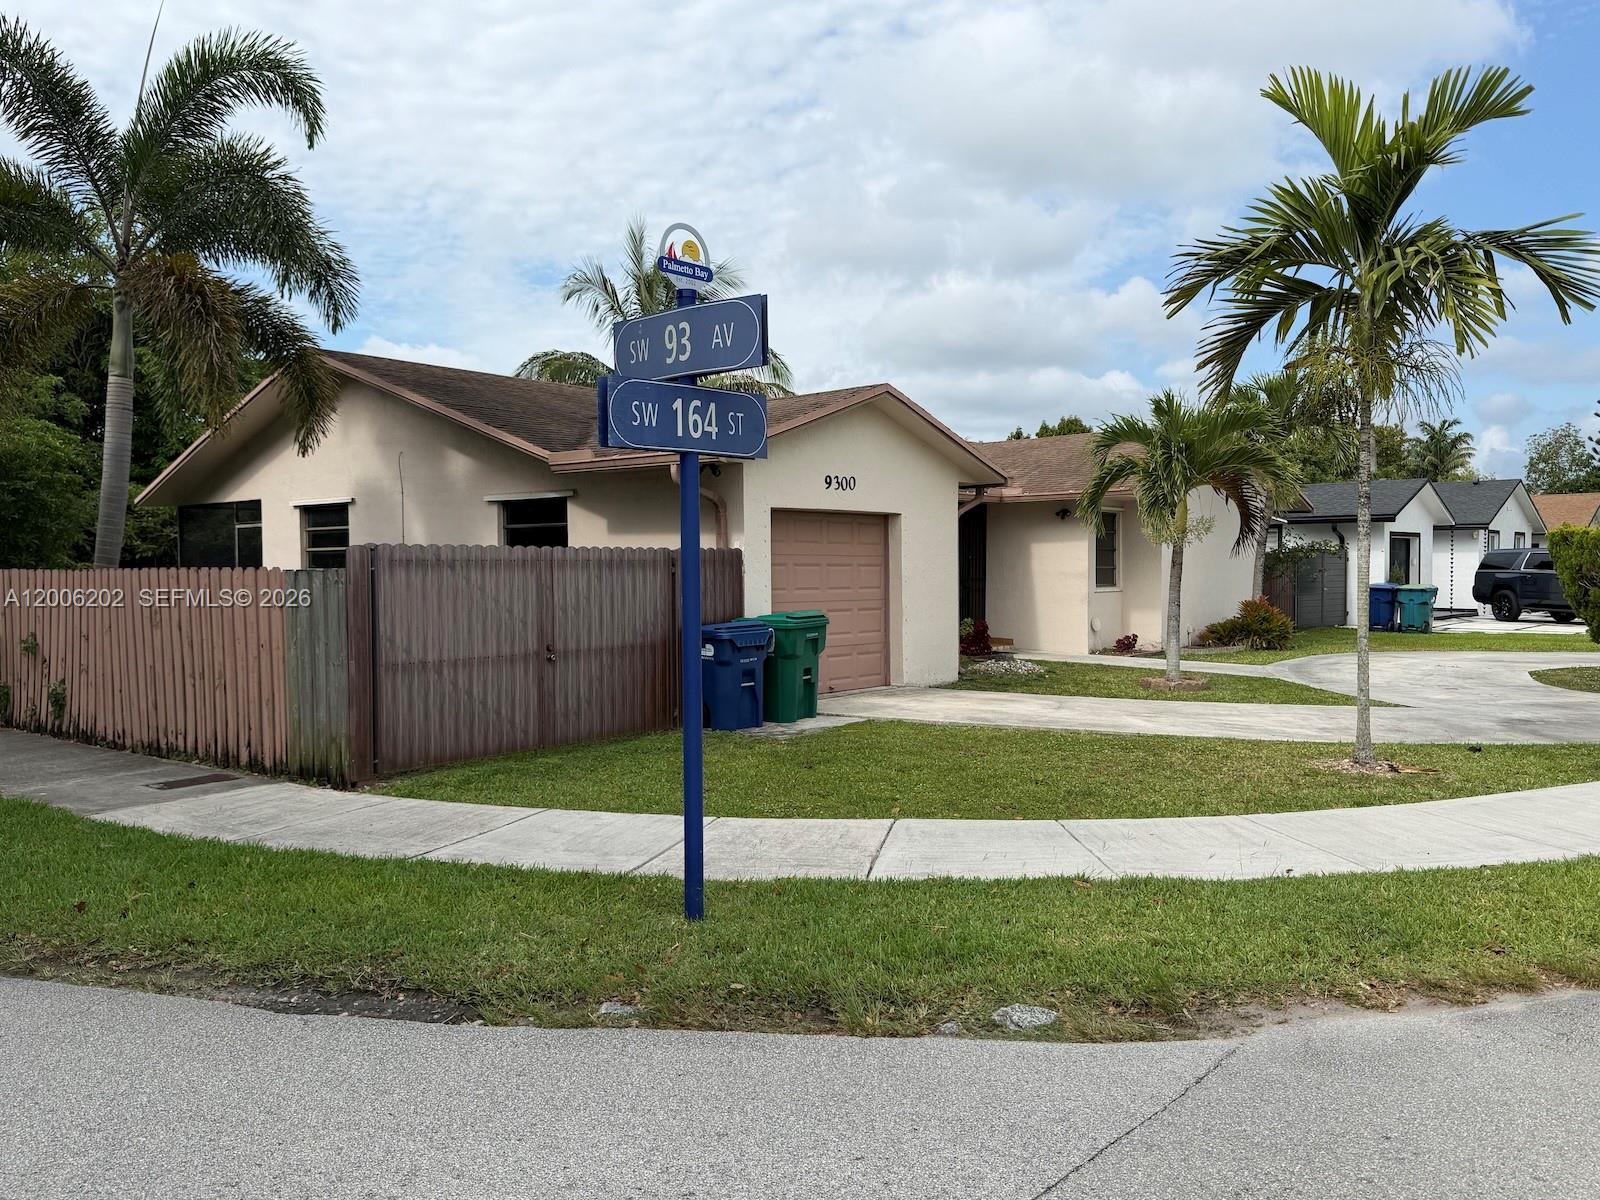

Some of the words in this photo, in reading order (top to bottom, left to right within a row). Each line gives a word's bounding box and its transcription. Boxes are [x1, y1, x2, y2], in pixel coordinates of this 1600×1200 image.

[663, 260, 694, 274] Palmetto
[695, 267, 709, 280] Bay
[629, 338, 649, 364] SW
[664, 321, 691, 364] 93
[711, 322, 734, 349] AV
[631, 401, 658, 427] SW
[672, 398, 718, 440] 164
[728, 412, 744, 436] ST
[824, 475, 856, 491] 9300
